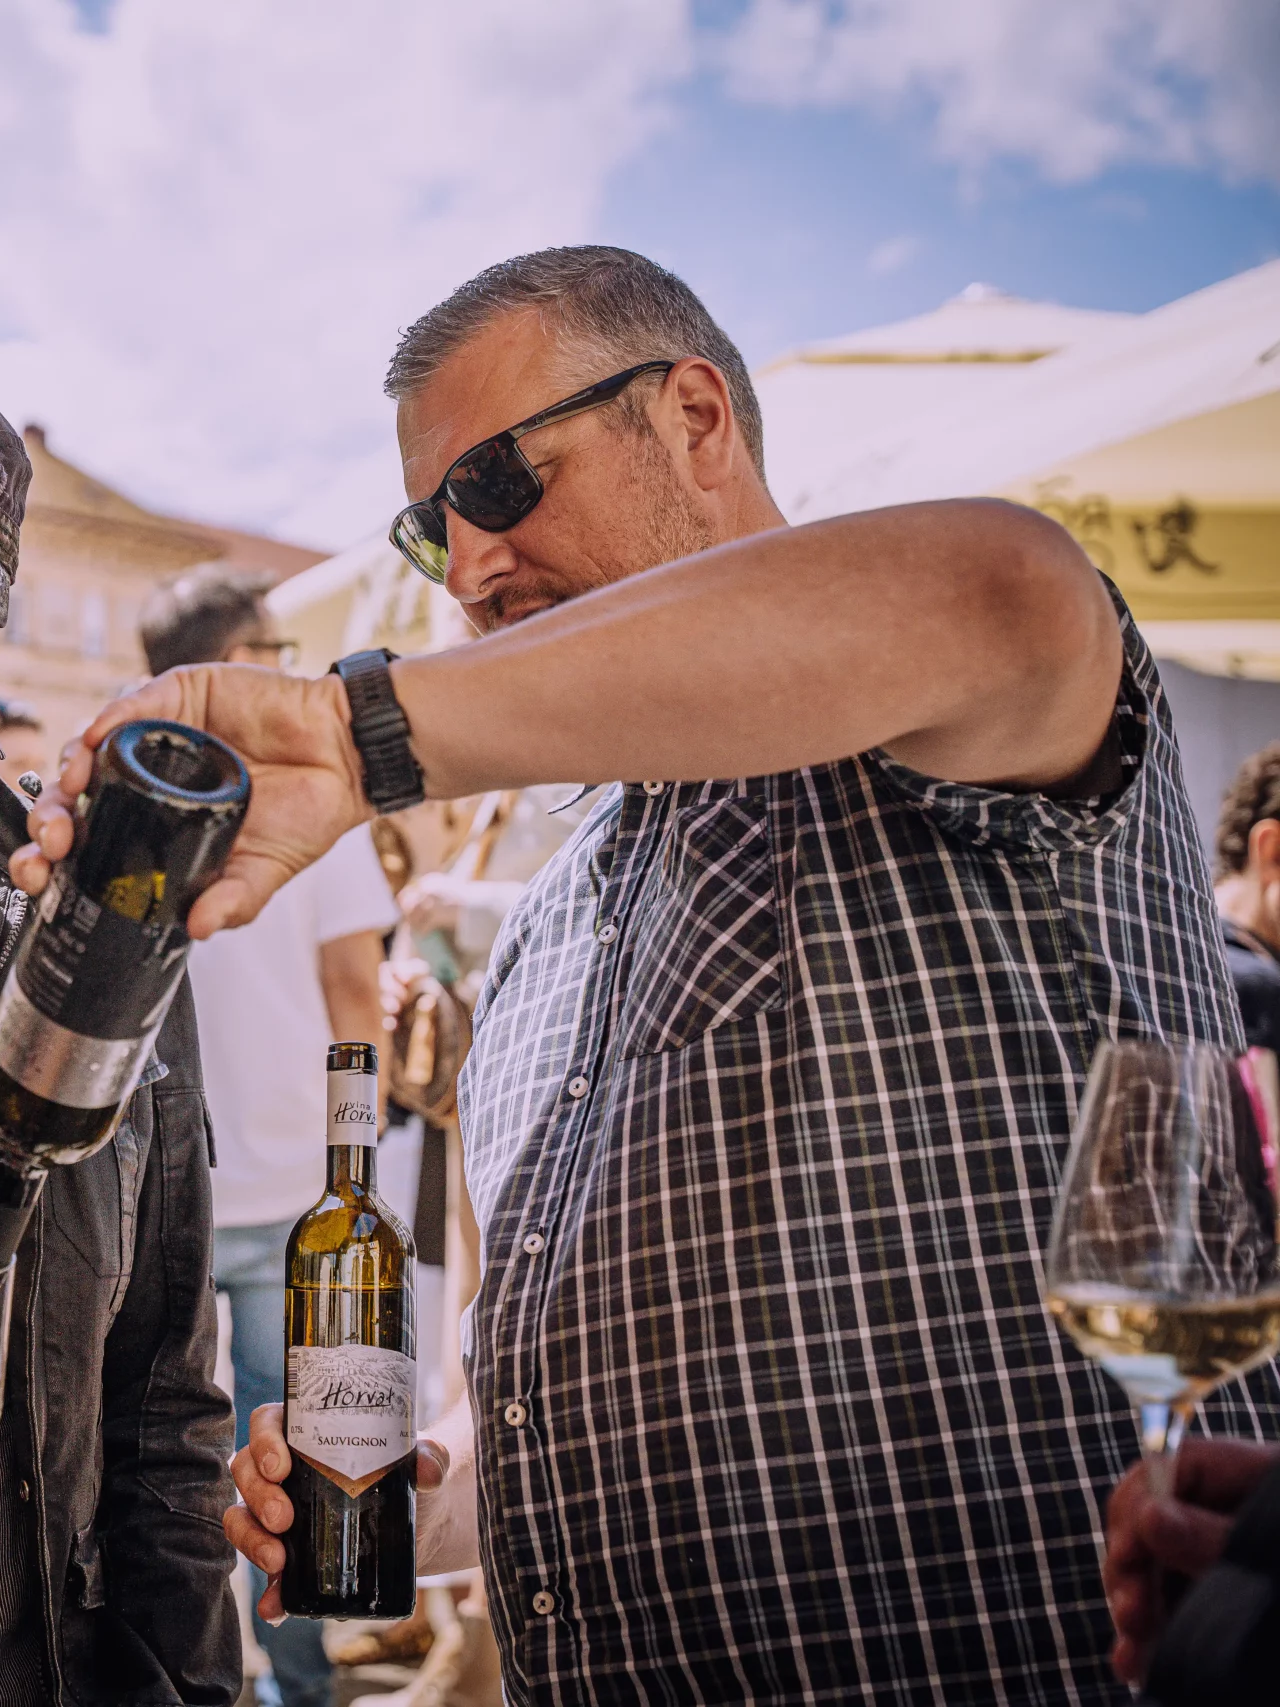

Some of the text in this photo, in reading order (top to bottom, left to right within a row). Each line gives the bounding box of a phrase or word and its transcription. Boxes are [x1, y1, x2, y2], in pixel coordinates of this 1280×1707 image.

[349, 1101, 371, 1110] vina
[321, 1382, 395, 1408] Horvat
[317, 1436, 387, 1447] SAUVIGNON
